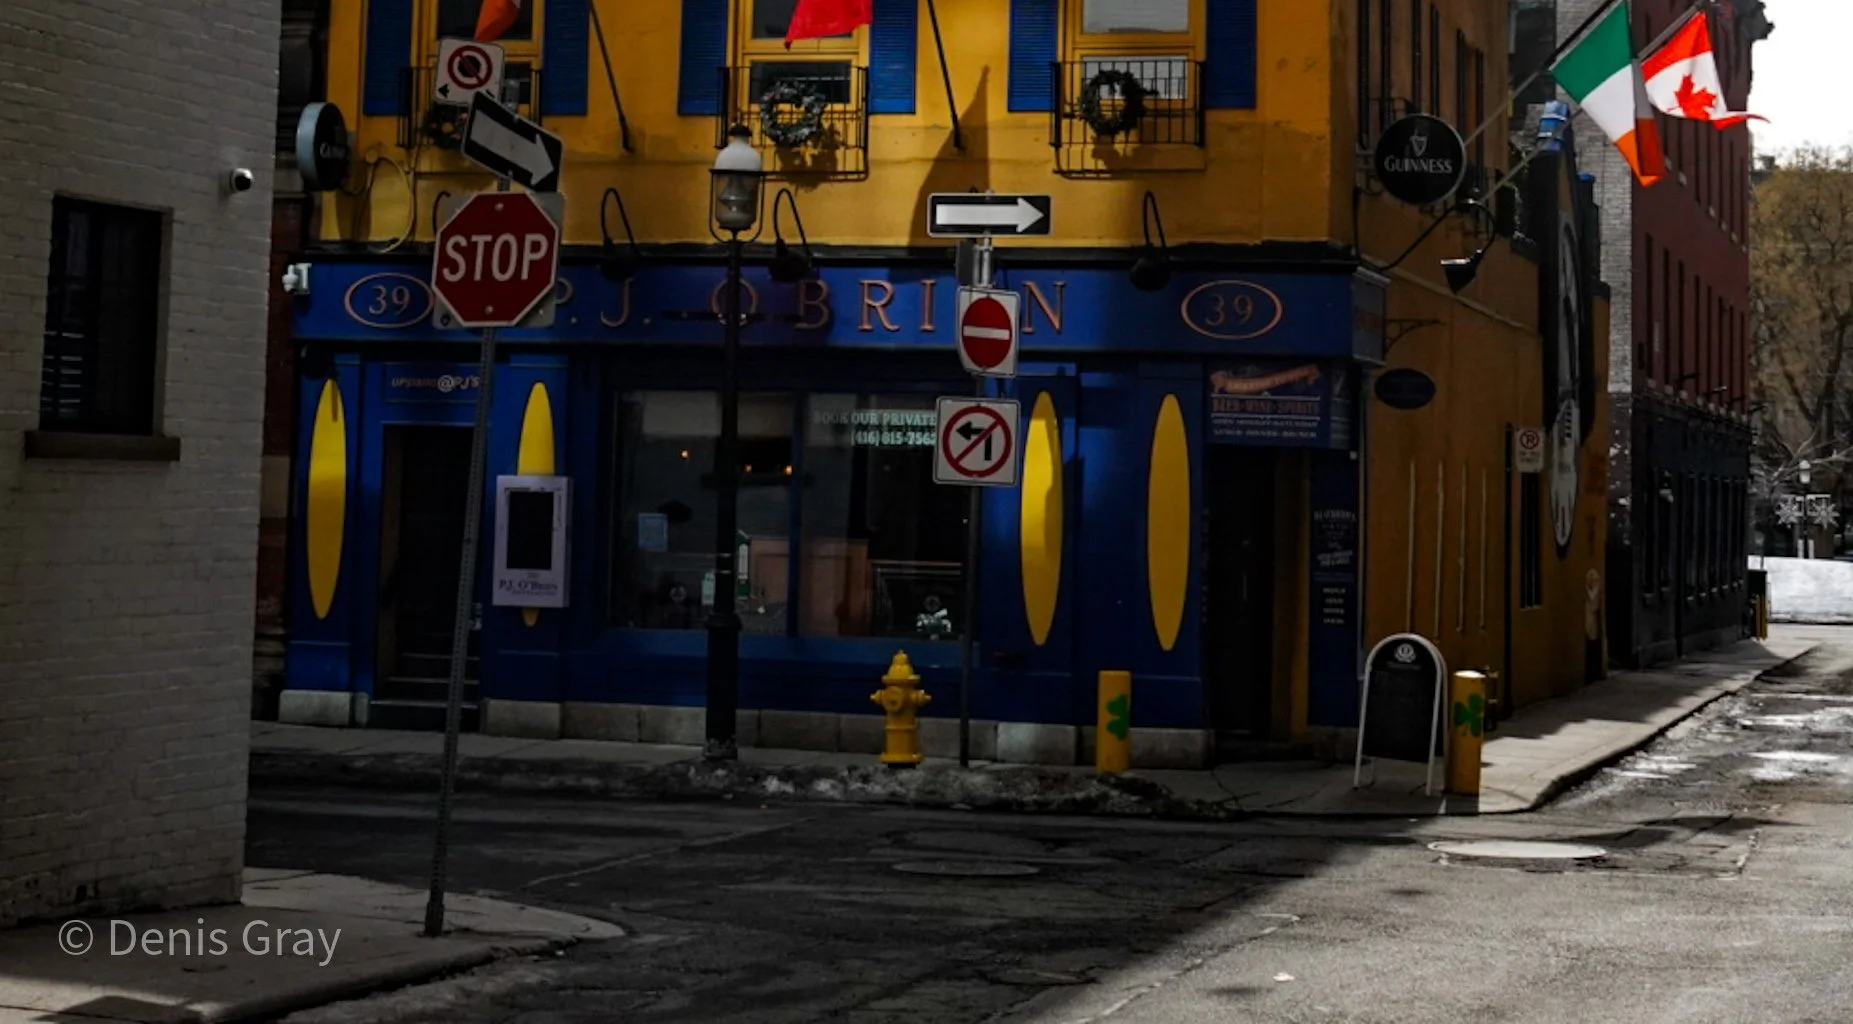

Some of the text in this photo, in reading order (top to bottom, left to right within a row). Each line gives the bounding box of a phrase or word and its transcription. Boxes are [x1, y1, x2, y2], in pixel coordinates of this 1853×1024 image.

[1384, 154, 1453, 174] GUINNESS
[442, 232, 549, 282] STOP
[368, 284, 412, 317] 39
[1204, 293, 1254, 327] 39
[851, 412, 878, 426] OUR
[882, 412, 937, 426] PRIVATE
[851, 429, 880, 447] (416)
